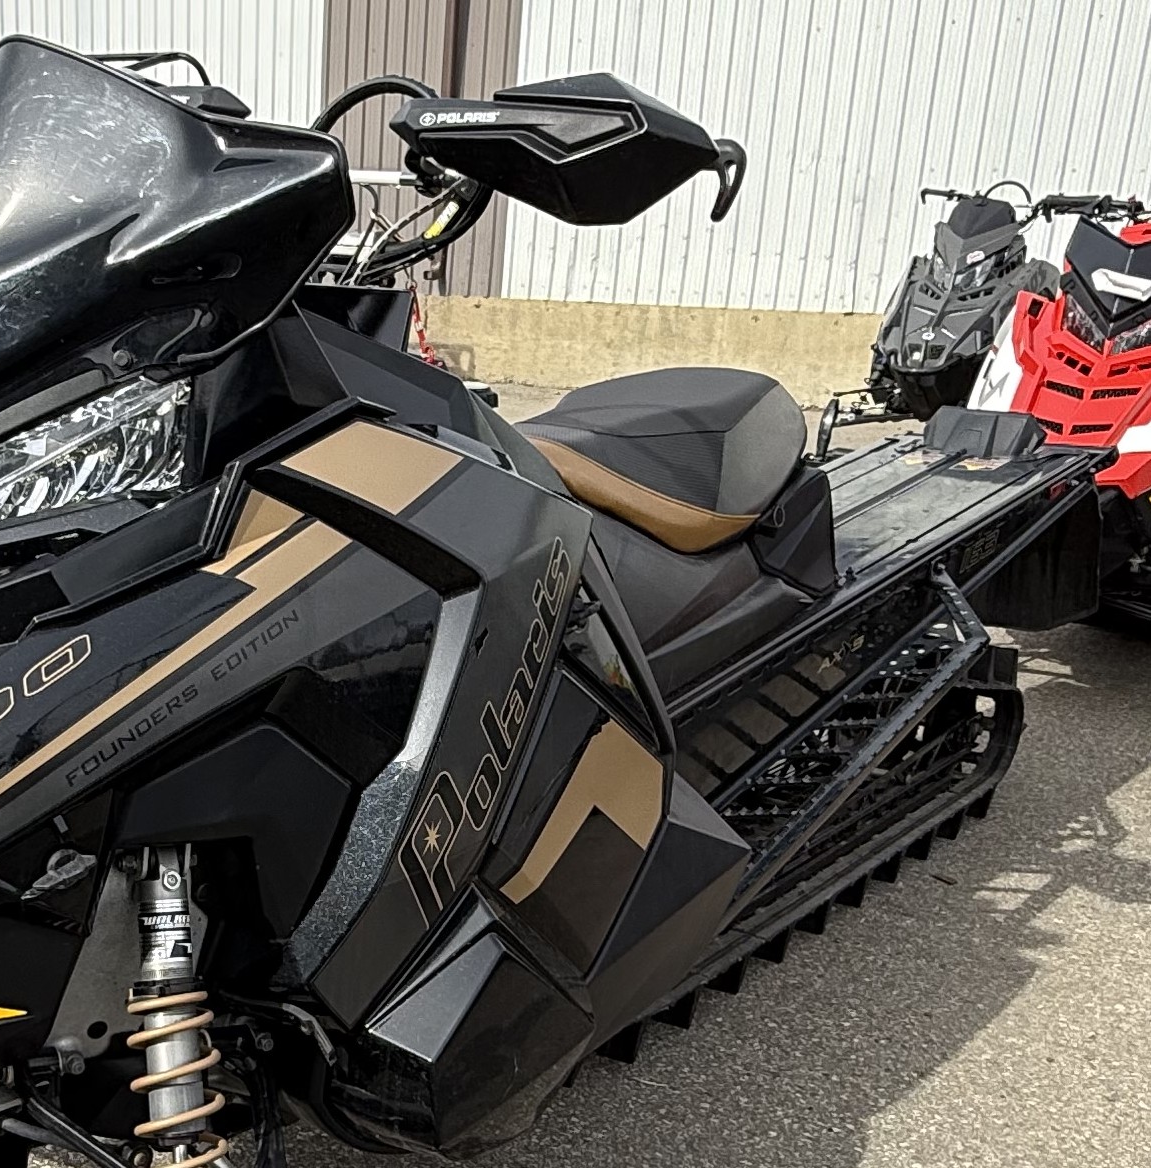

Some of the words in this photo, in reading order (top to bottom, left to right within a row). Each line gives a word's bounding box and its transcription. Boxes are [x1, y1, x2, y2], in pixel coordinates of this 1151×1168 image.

[437, 112, 500, 124] POLARIS
[65, 684, 199, 787] FOUNDERS
[210, 609, 299, 682] EDITION
[398, 536, 571, 930] Polaris
